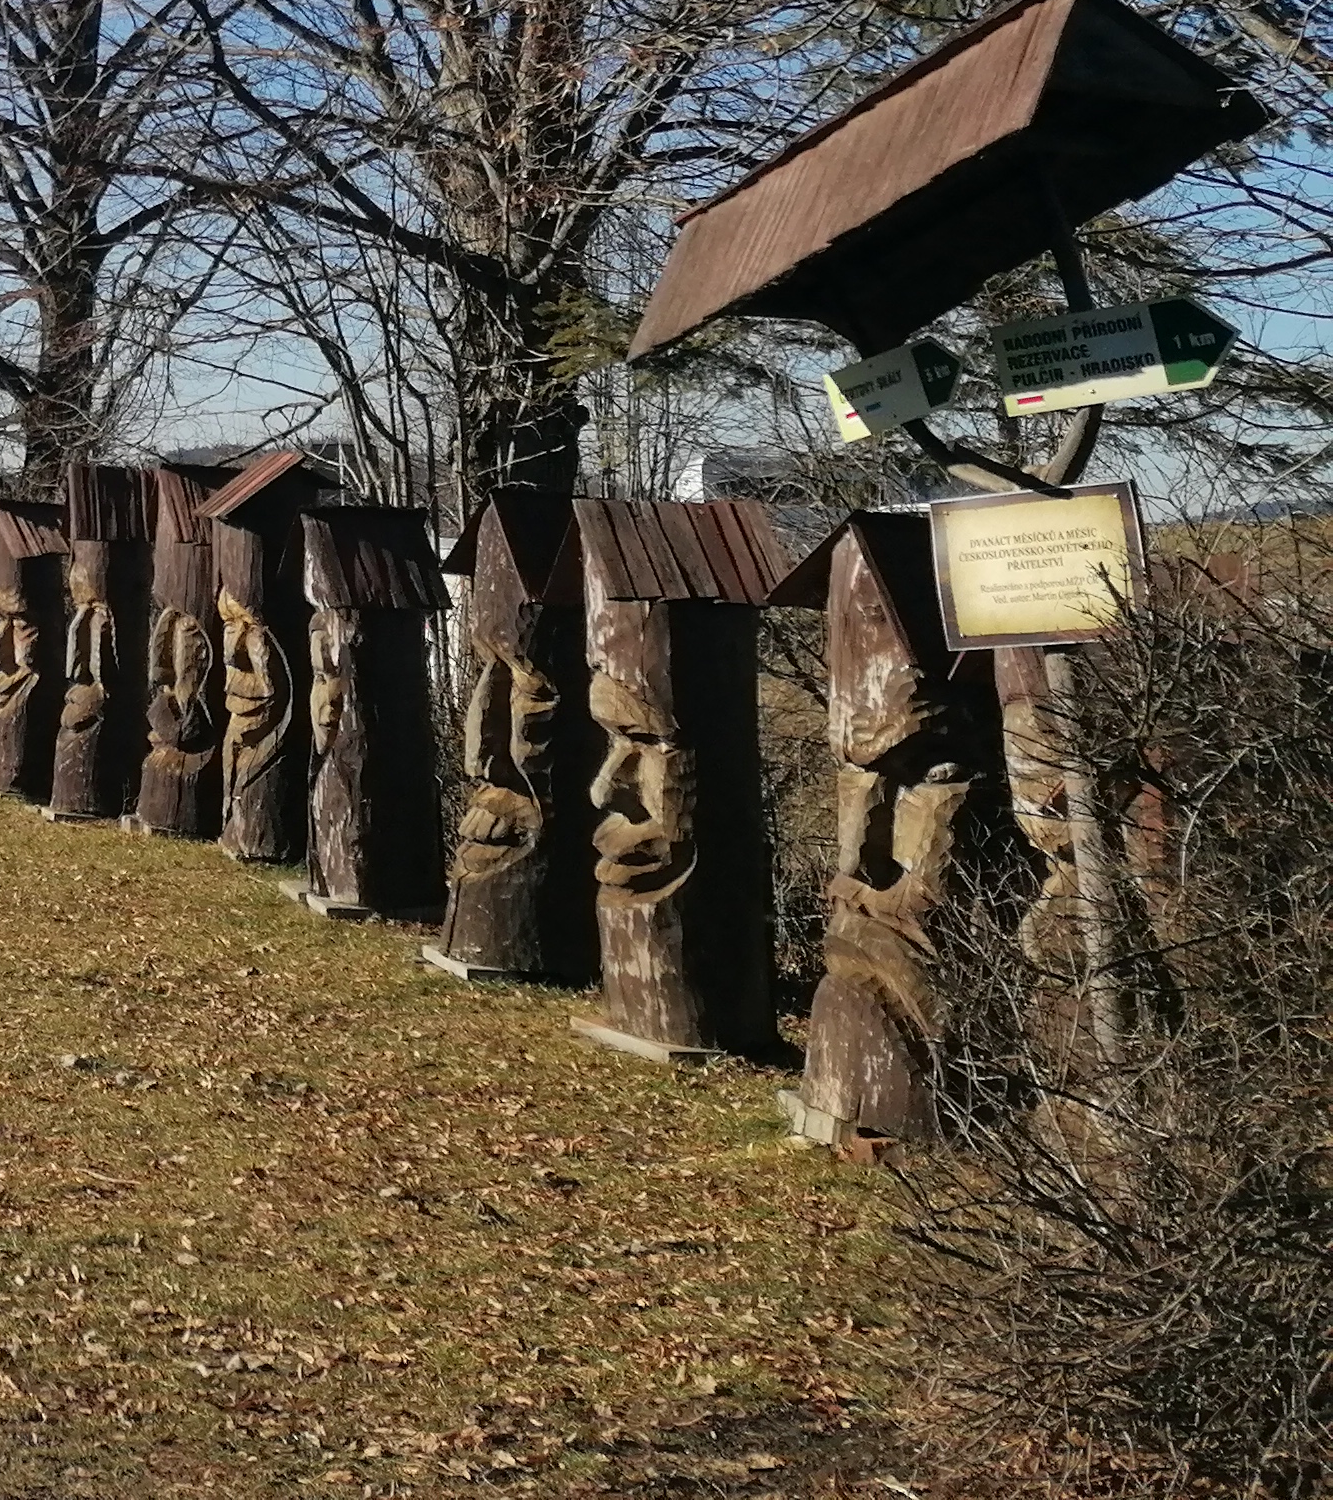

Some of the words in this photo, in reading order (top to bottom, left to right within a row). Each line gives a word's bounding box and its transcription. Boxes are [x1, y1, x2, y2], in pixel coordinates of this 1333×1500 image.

[1002, 325, 1067, 352] NÁRODNÍ
[1072, 311, 1143, 341] PŘÍRODNÍ
[1172, 334, 1182, 349] 1
[1189, 332, 1215, 347] km
[1006, 343, 1091, 370] REZERVACE
[1079, 352, 1156, 378] HRADISKO
[970, 534, 1011, 549] DVANÁCT
[1013, 529, 1056, 545] MĚSÍČKŮ
[1058, 531, 1065, 541] A
[1065, 527, 1097, 540] MĚSÍC
[1007, 556, 1065, 571] PŘÁTELSTVÍ
